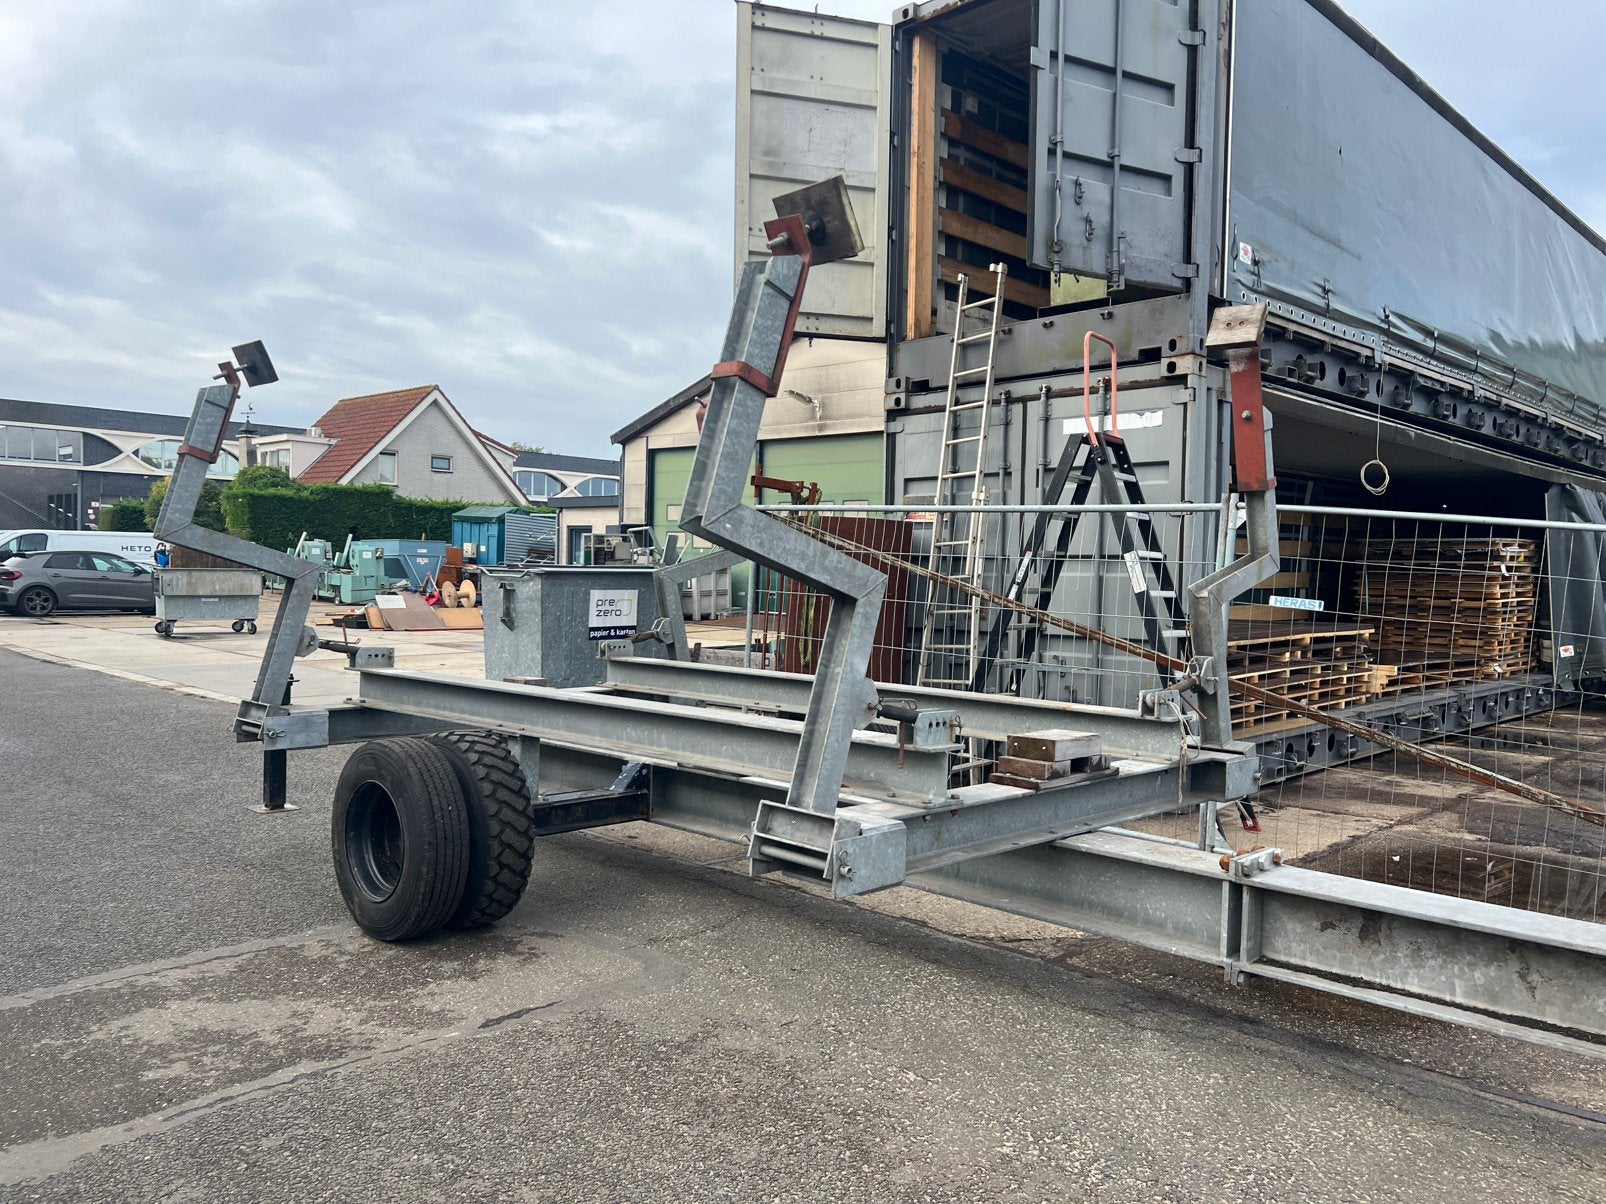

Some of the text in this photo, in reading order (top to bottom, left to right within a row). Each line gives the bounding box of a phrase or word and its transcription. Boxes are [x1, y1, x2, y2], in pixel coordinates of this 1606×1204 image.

[596, 599, 615, 608] pre
[1274, 597, 1316, 609] HERAS
[596, 609, 622, 617] zero
[590, 629, 609, 638] papier
[616, 628, 636, 636] karton
